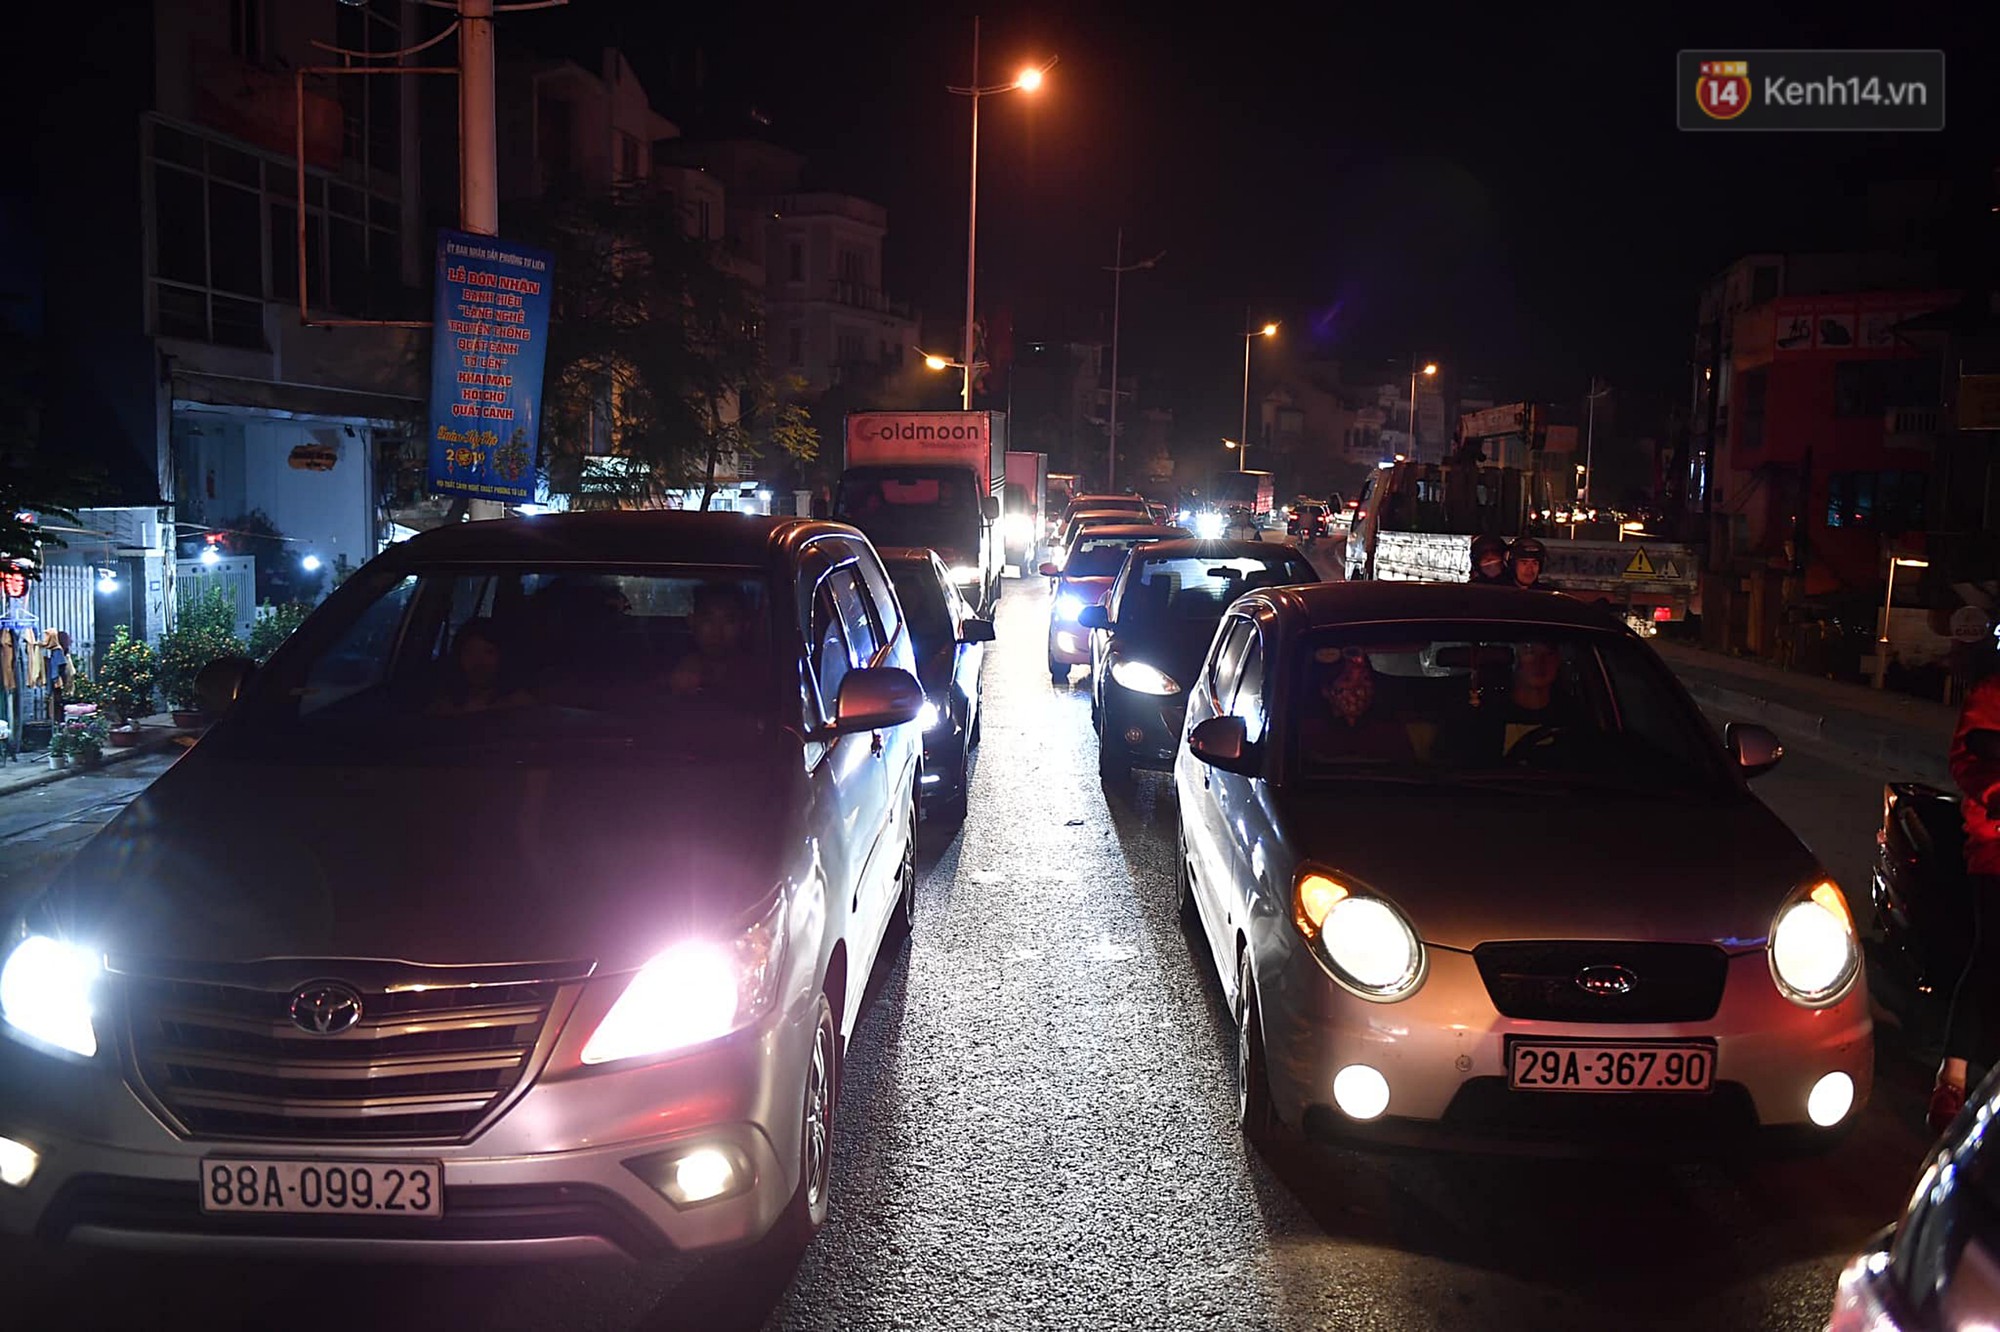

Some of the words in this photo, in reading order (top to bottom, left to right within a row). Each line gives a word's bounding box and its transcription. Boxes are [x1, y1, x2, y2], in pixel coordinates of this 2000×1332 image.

[457, 371, 485, 384] KHAI
[1518, 1050, 1705, 1087] 29A-367.90
[210, 1165, 431, 1211] 88A-099.23
